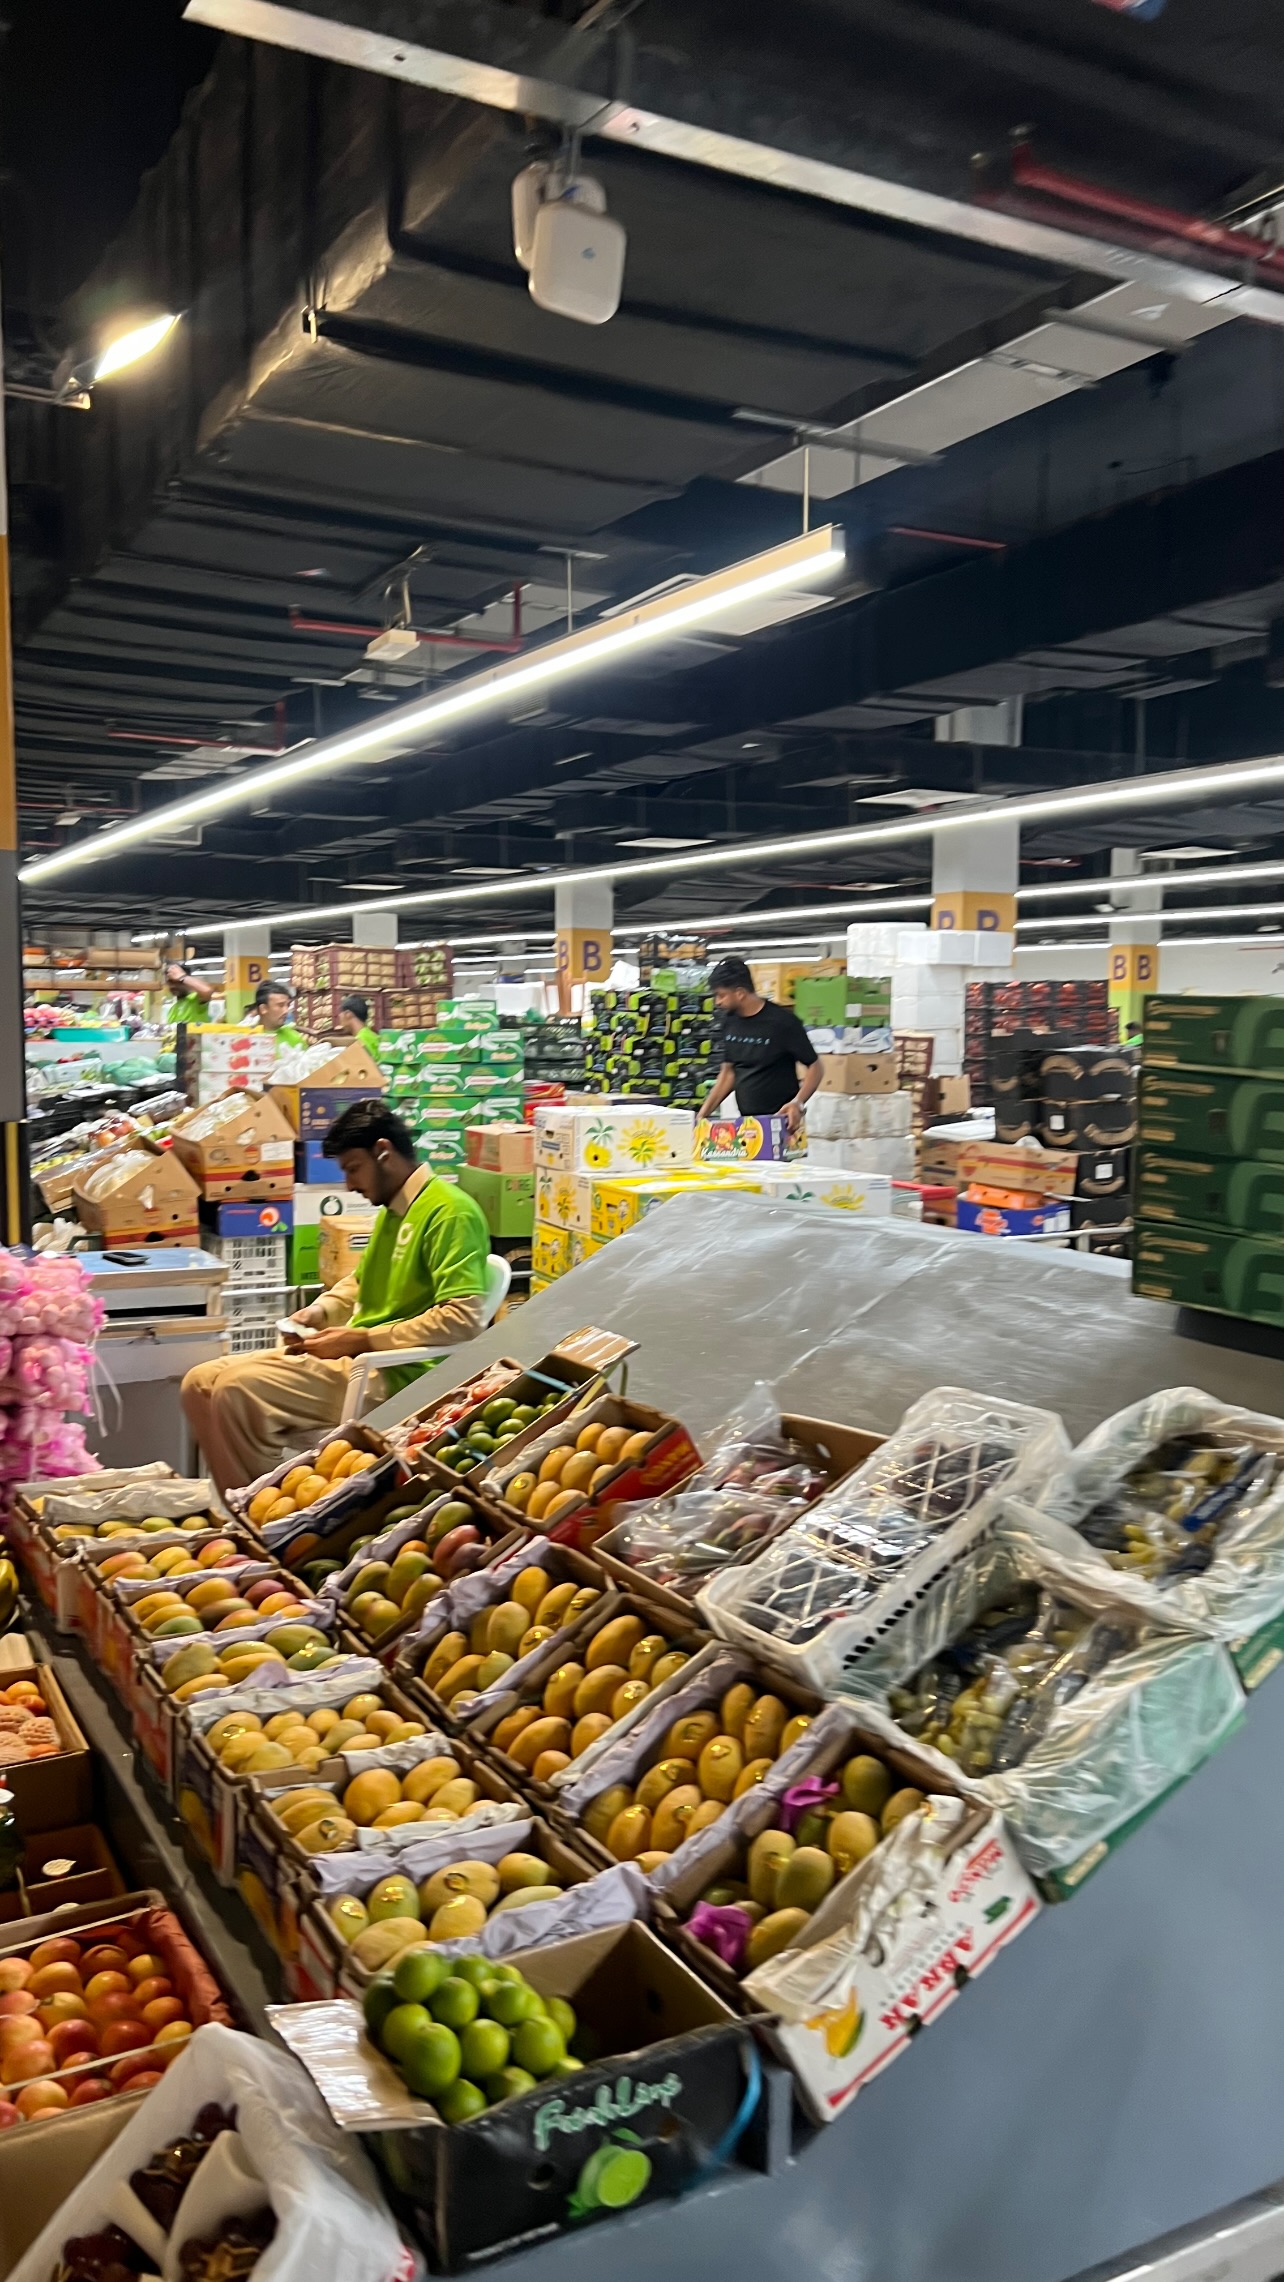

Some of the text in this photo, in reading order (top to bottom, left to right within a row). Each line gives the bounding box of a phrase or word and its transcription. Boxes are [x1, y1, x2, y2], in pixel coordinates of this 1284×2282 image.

[558, 940, 570, 972] B
[583, 941, 602, 971] B
[1113, 954, 1127, 980] B
[1137, 954, 1152, 980] B
[248, 963, 263, 983] B
